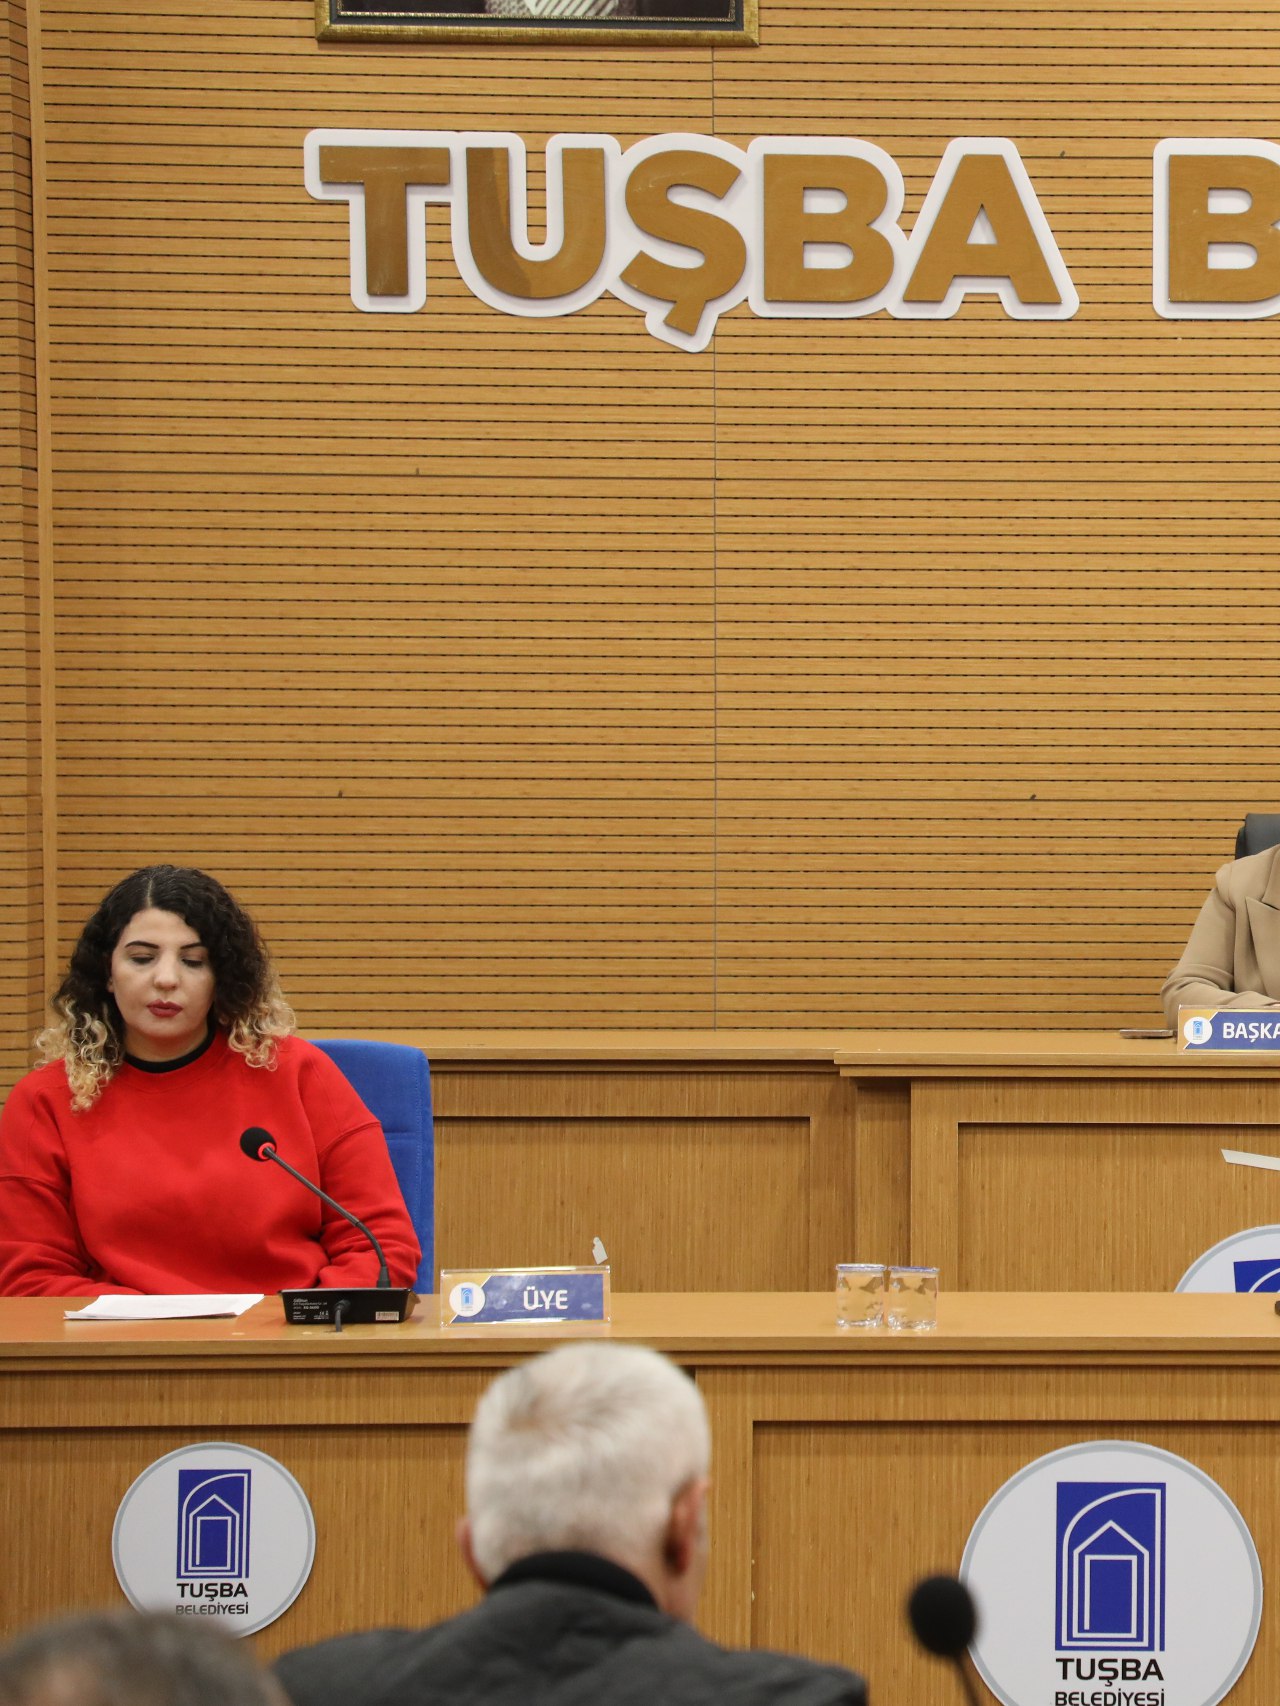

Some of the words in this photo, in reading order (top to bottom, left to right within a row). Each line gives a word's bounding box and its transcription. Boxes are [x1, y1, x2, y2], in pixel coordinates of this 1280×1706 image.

[317, 144, 1063, 337] TUŞBA
[523, 1285, 569, 1311] ÜYE
[176, 1582, 249, 1602] TUŞBA
[175, 1601, 249, 1615] BELEDİYESİ
[1055, 1658, 1165, 1687] TUŞBA
[1055, 1688, 1165, 1706] BELEDİYESİ
